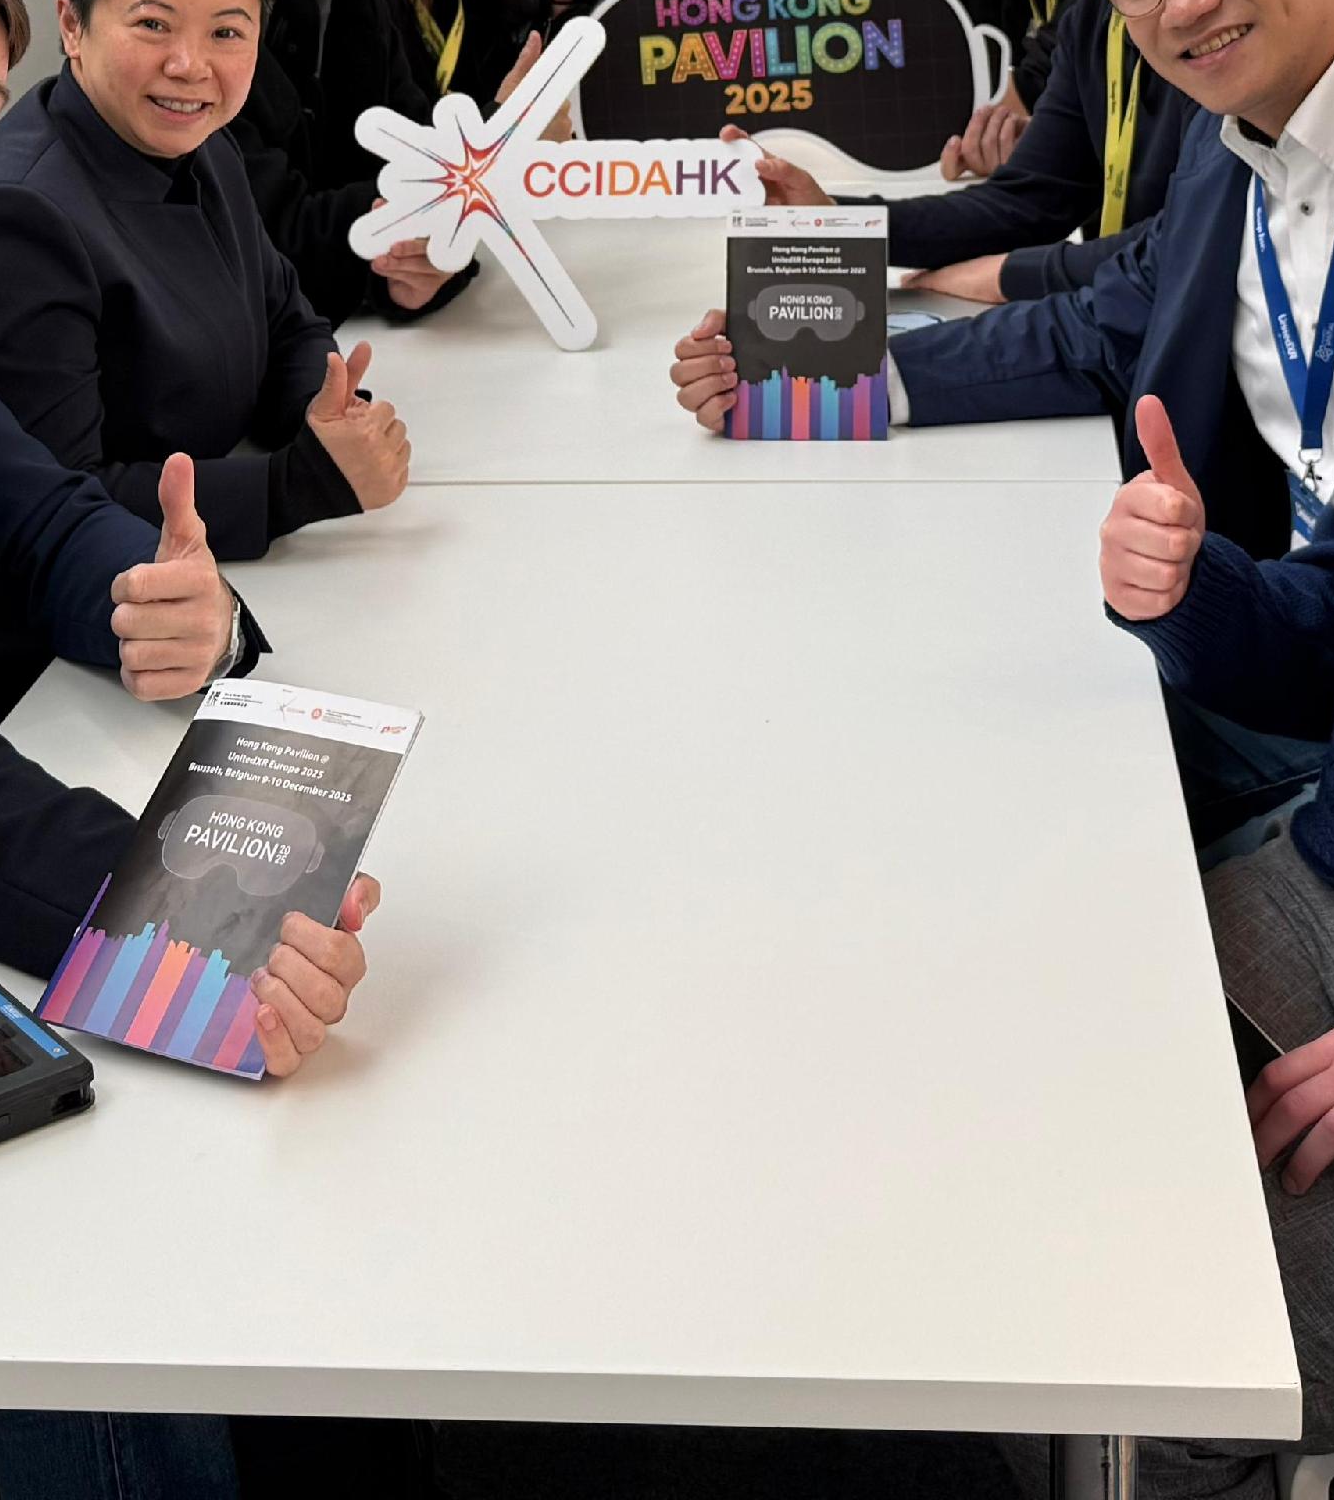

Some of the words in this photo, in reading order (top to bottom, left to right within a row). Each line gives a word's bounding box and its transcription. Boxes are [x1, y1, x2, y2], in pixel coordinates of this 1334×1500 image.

[639, 19, 905, 85] PAVILION
[724, 79, 813, 115] 2025
[523, 159, 741, 198] CCIDAHK
[769, 306, 834, 320] PAVILION
[780, 295, 805, 305] HONG
[806, 295, 833, 305] KONG
[236, 737, 260, 750] Hong
[260, 742, 283, 755] Kong
[283, 746, 320, 762] Pavilion
[228, 752, 268, 767] UnitedXR
[267, 761, 300, 774] Europe
[300, 767, 325, 779] 2025
[189, 762, 223, 777] Brussels,
[225, 768, 260, 782] Belgium
[282, 779, 328, 797] December
[328, 789, 352, 802] 2025
[209, 811, 246, 829] HONG
[246, 819, 284, 838] KONG
[184, 824, 279, 863] PAVILION
[279, 845, 290, 855] 20
[275, 854, 287, 865] 25
